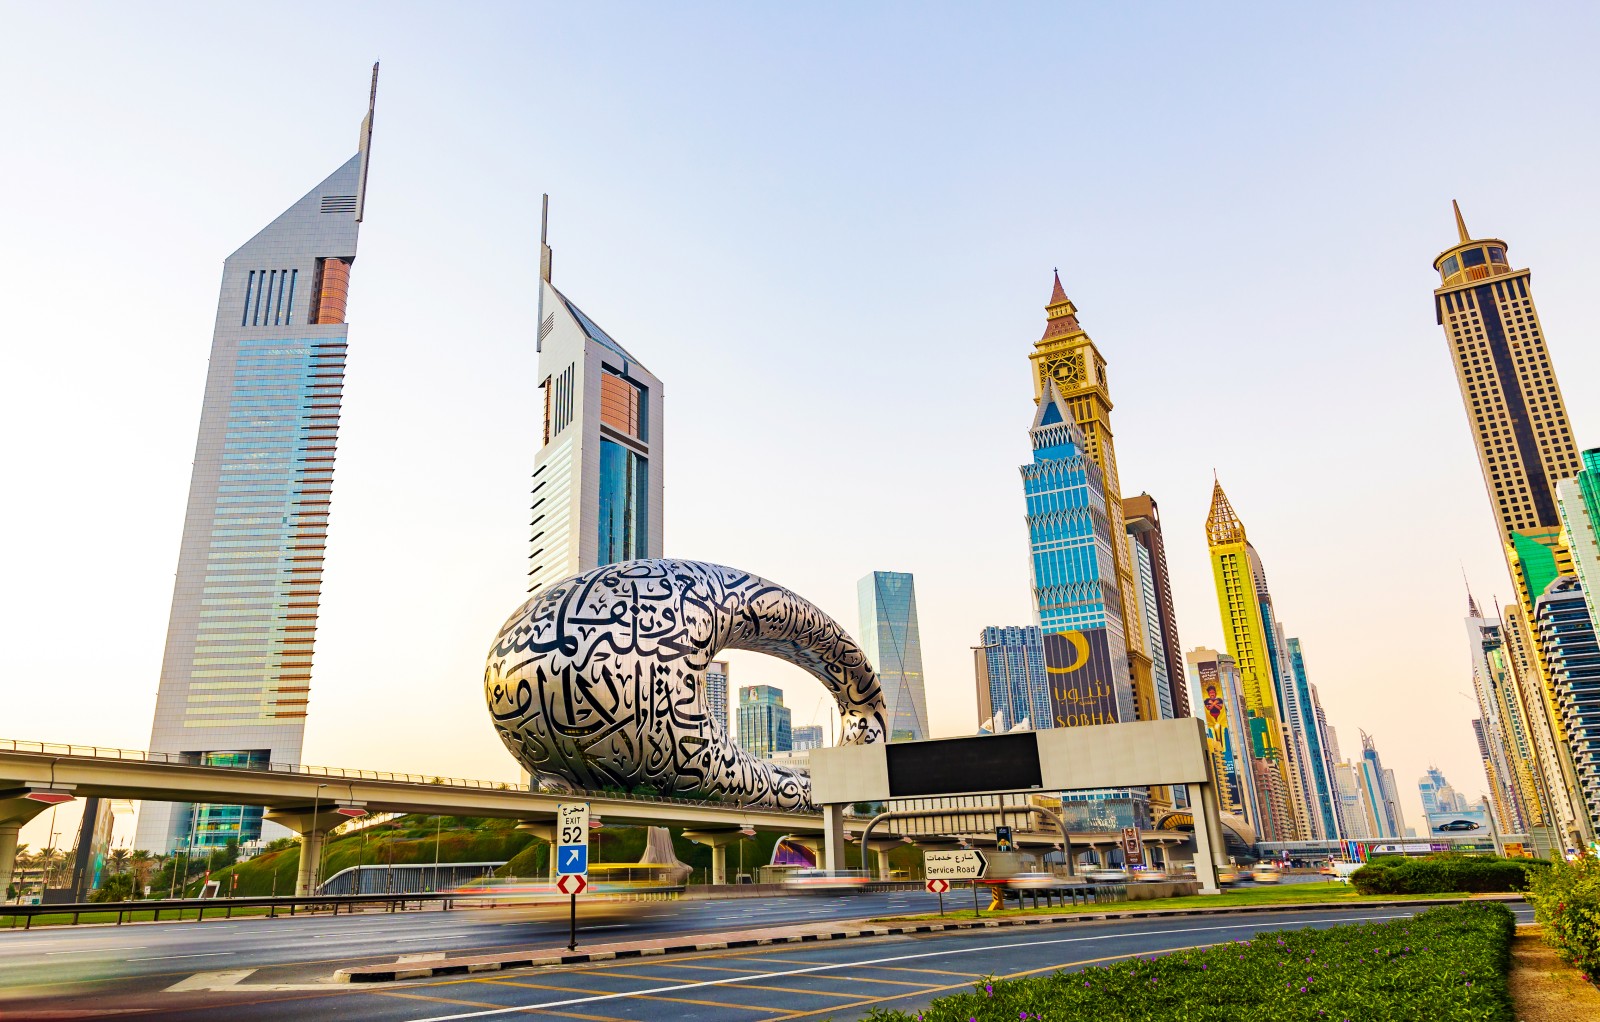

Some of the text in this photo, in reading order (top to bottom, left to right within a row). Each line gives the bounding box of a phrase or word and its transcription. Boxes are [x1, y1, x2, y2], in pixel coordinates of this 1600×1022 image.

[1057, 712, 1116, 728] SOBHA
[563, 806, 584, 816] مخرج
[565, 817, 581, 825] EXIT
[562, 826, 582, 843] 52
[955, 853, 974, 863] شارع
[927, 865, 976, 874] Service Road
